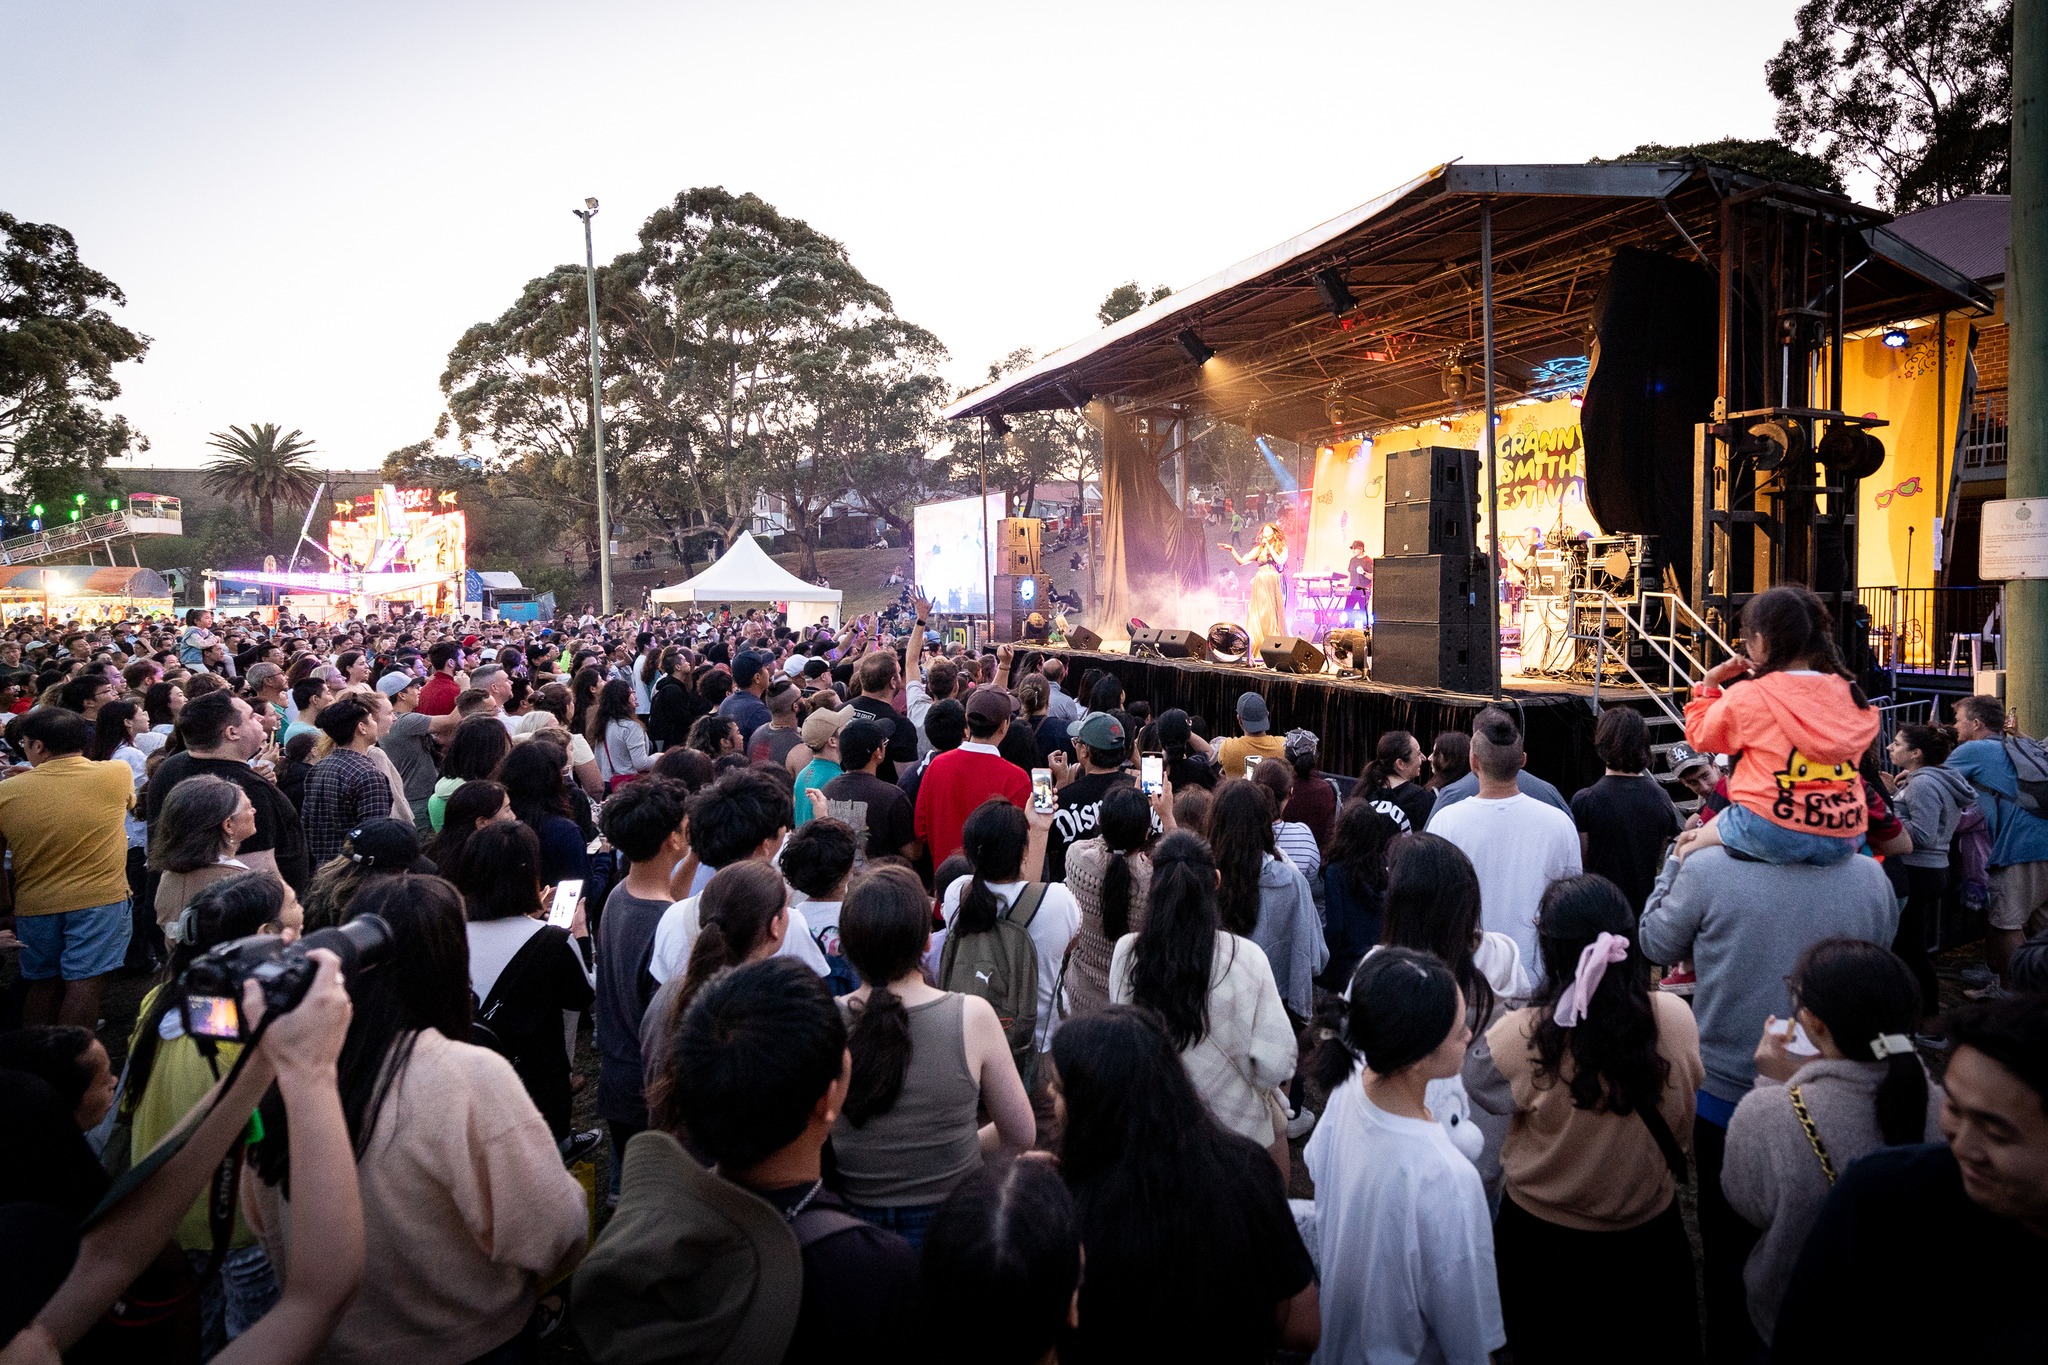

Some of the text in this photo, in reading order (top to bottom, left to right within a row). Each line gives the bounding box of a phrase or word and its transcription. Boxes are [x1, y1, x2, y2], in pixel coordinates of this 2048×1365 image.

[1501, 452, 1578, 485] SMITH
[1673, 747, 1689, 762] LA
[216, 1157, 235, 1219] Canon
